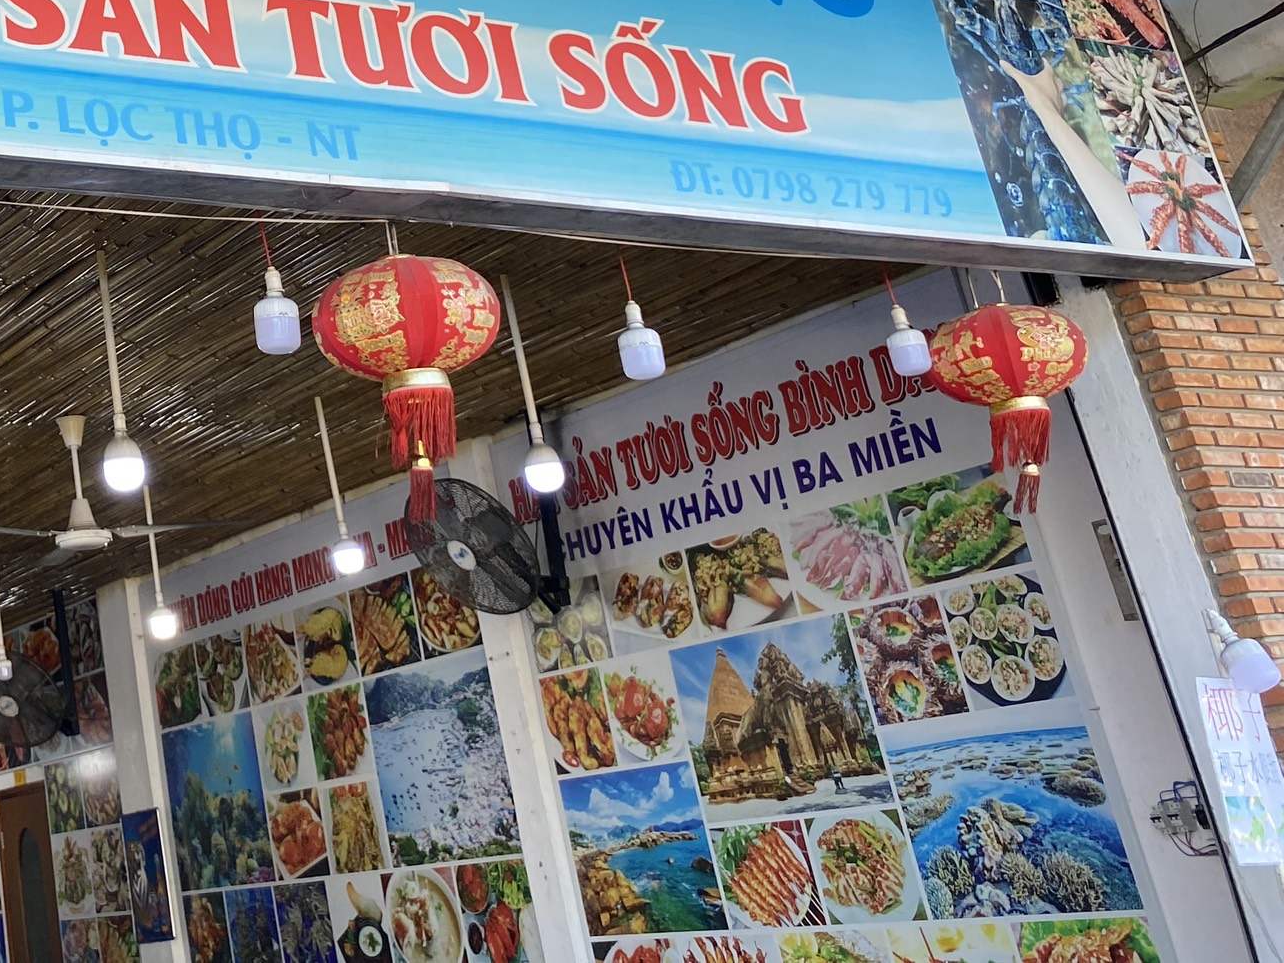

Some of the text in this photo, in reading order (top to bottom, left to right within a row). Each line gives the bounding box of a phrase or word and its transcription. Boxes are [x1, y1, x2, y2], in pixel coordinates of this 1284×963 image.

[547, 17, 809, 134] SỐNG
[2, 88, 39, 130] P.
[163, 106, 262, 160] THỌ
[307, 122, 361, 161] NT
[670, 159, 953, 218] ĐT: 0798 279 779
[615, 413, 693, 489] TƯƠI
[691, 381, 779, 467] SỐNG
[778, 356, 875, 438] BÌNH
[562, 409, 942, 561] HUYÊN KHẨU VỊ BA MIỀN
[291, 546, 336, 593] MANG
